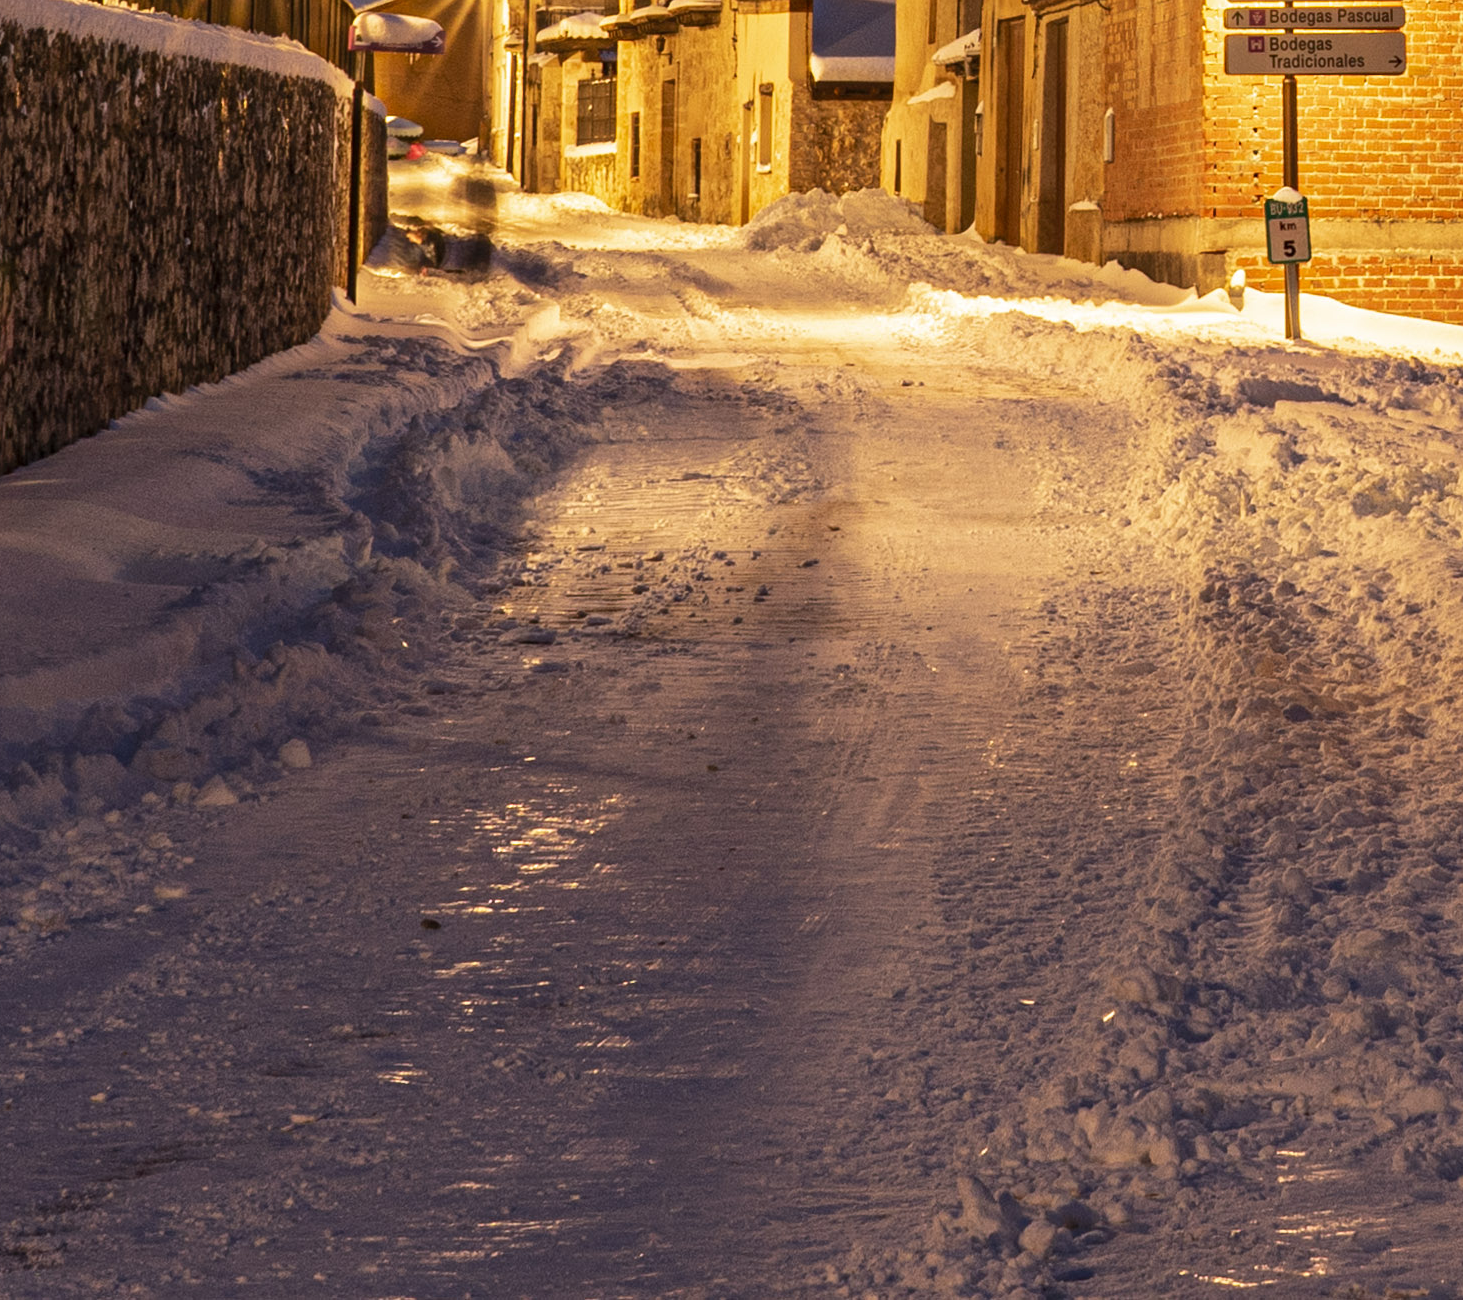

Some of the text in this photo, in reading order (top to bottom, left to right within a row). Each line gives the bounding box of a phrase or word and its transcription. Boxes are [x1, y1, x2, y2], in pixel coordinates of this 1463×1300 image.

[1269, 9, 1394, 26] Bodegas Pascual
[1269, 37, 1333, 54] Bodegas
[1269, 54, 1365, 69] Tradicionales
[1279, 221, 1297, 231] km
[1283, 240, 1296, 257] 5
